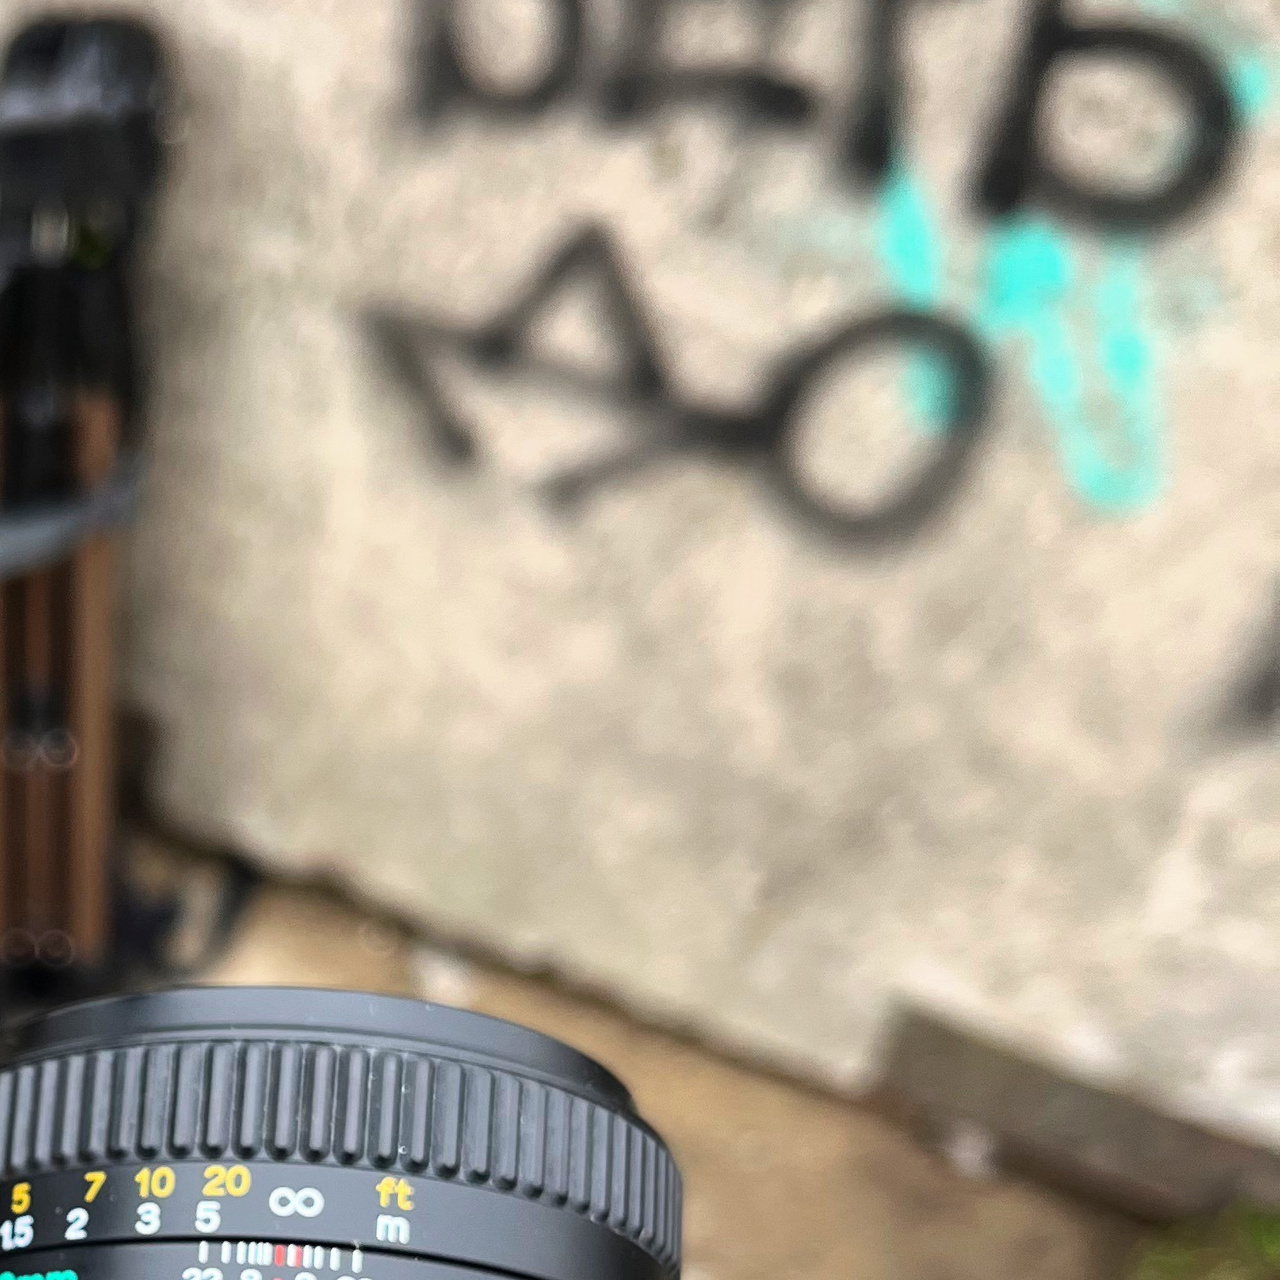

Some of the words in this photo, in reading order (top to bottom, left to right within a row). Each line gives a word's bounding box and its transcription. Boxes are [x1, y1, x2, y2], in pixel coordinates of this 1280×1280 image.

[11, 1181, 31, 1215] 5
[84, 1171, 107, 1203] 7
[134, 1165, 176, 1199] 10
[202, 1164, 252, 1198] 20
[375, 1176, 415, 1212] ft
[64, 1207, 89, 1241] 2
[134, 1201, 161, 1236] 3
[195, 1200, 221, 1234] 5
[376, 1213, 411, 1245] m
